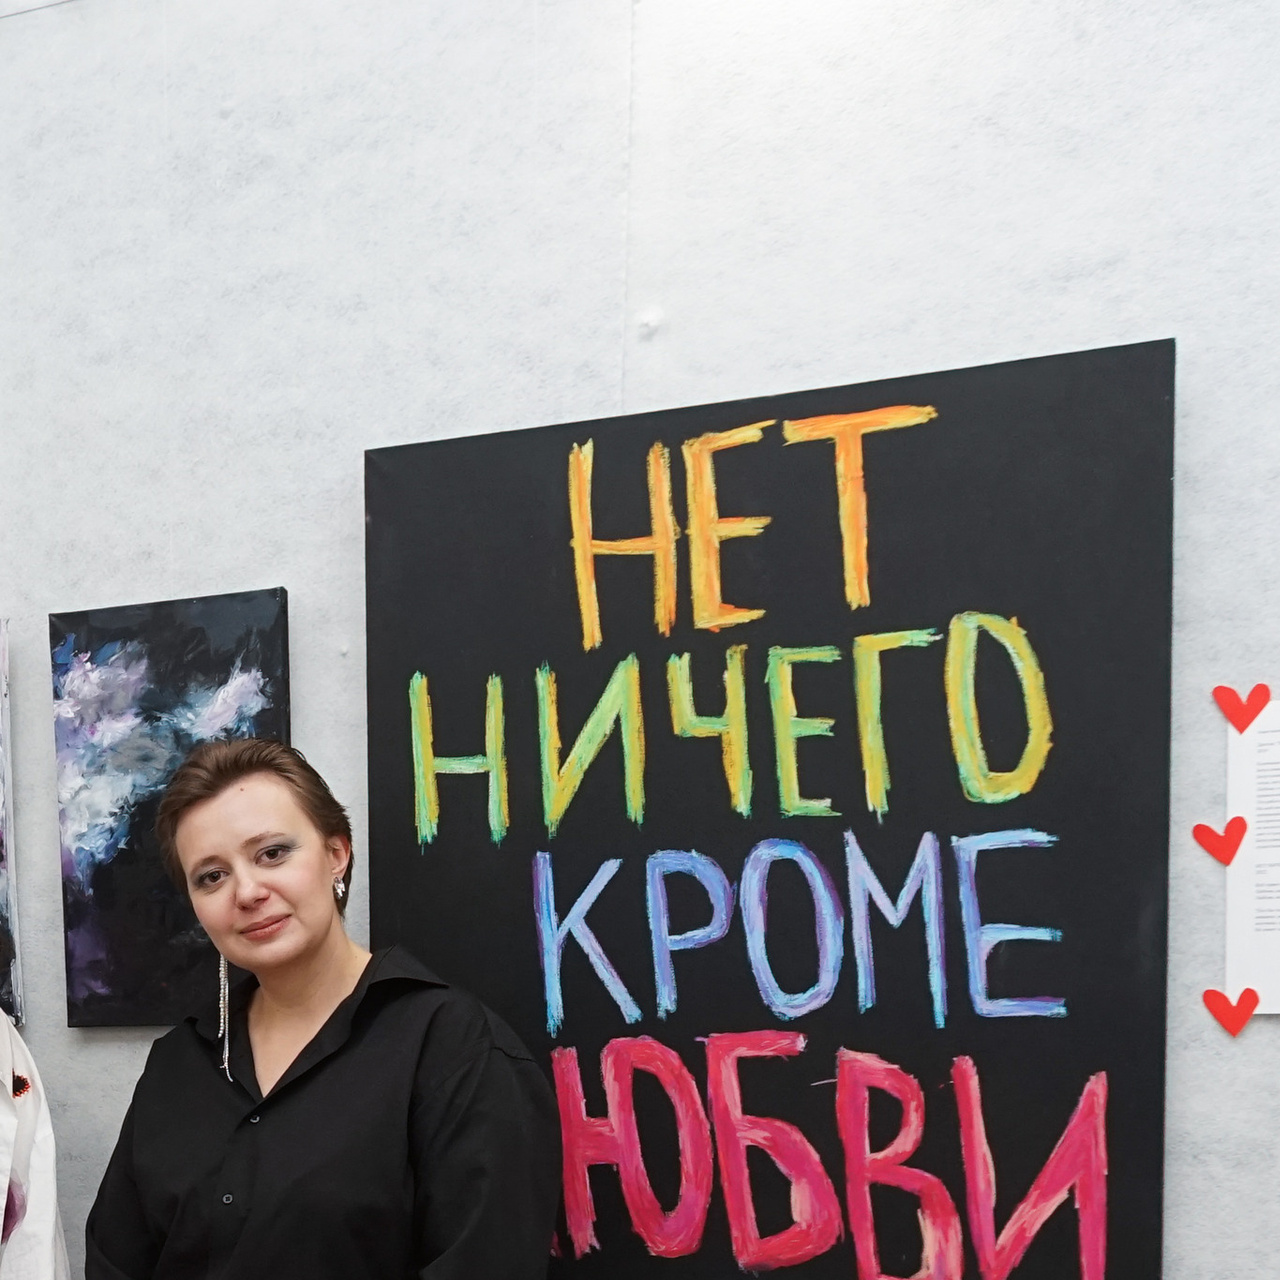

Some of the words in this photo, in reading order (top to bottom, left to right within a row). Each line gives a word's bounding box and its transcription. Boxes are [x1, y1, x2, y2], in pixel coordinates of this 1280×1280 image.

[568, 404, 938, 652] НЕТ
[408, 611, 1055, 848] НИЧЕГО
[531, 827, 1068, 1036] КРОМЕ
